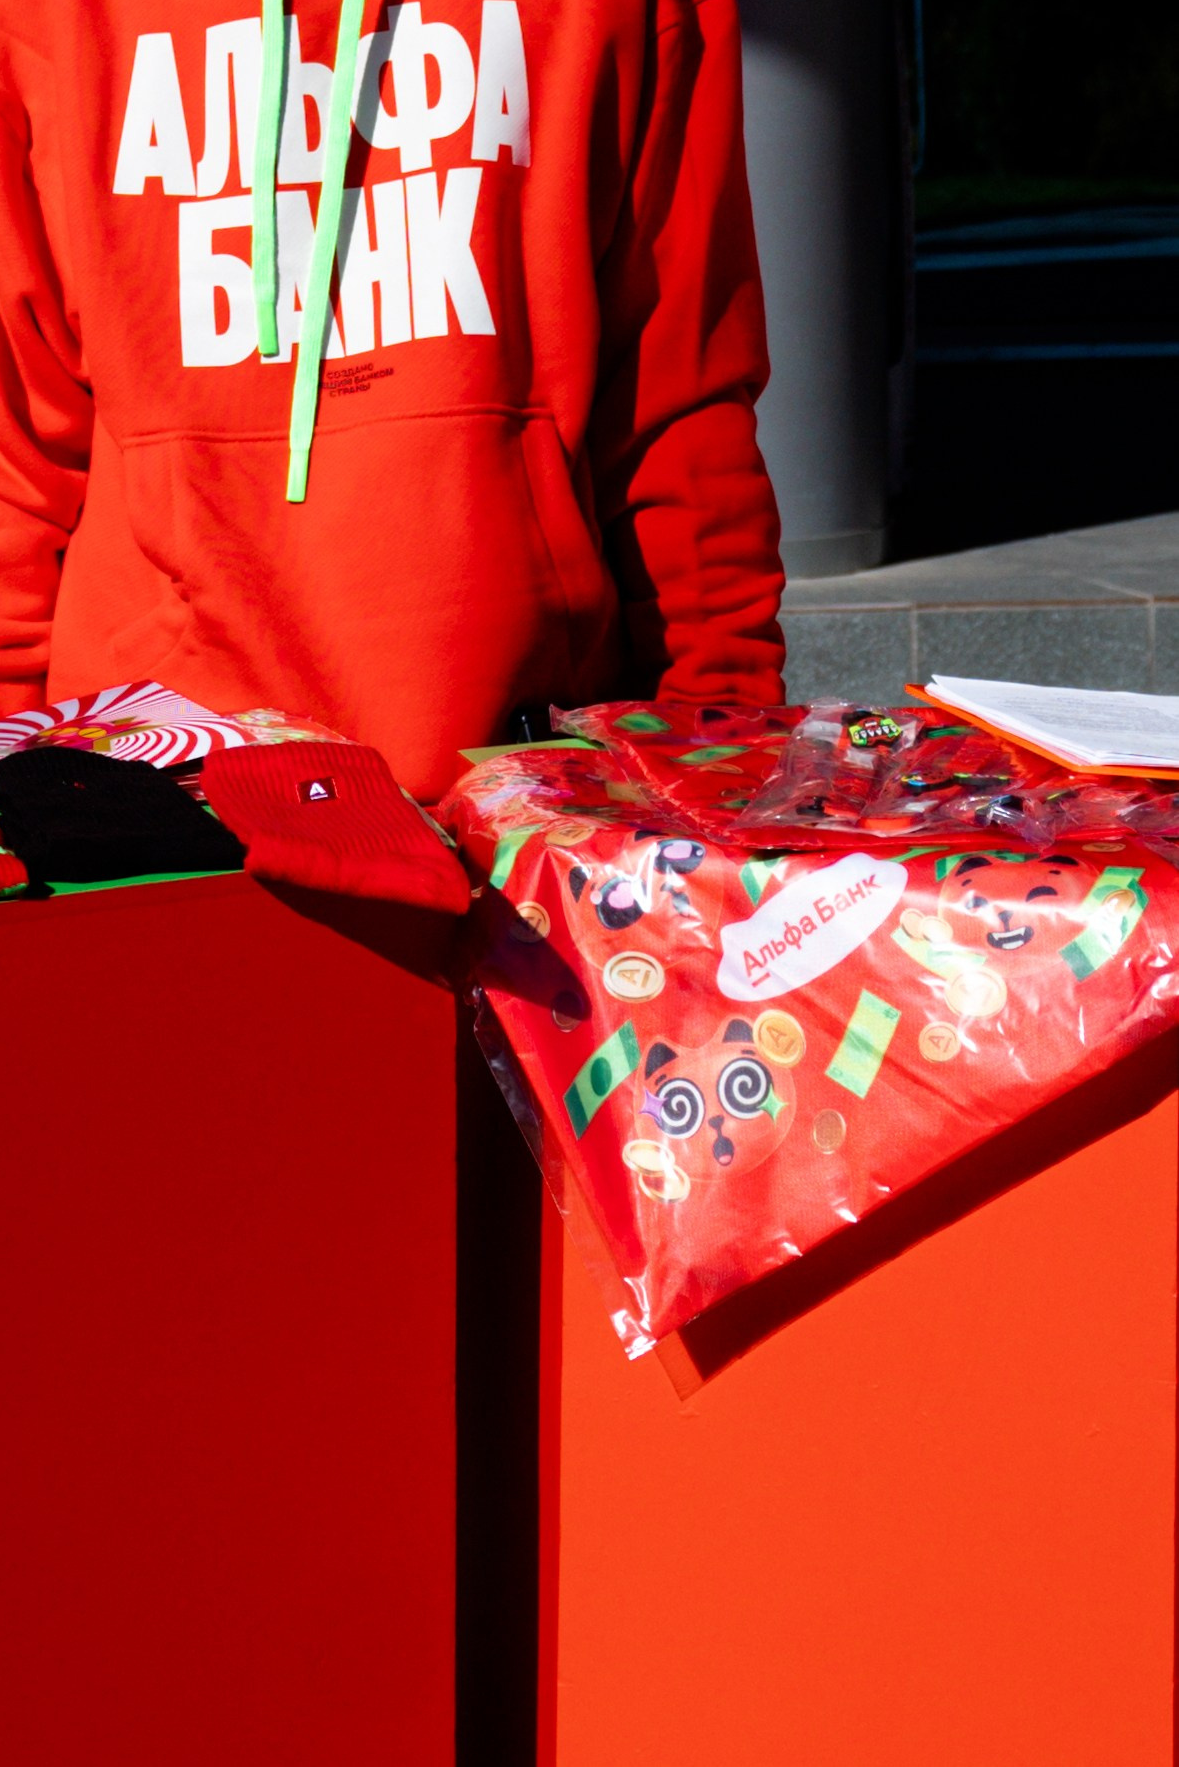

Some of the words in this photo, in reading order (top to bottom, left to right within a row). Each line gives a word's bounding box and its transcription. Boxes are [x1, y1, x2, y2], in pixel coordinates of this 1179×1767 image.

[113, 0, 531, 197] АЛЬФА
[179, 167, 497, 367] БАНК
[329, 383, 371, 398] СТРАНЫ
[743, 915, 818, 979] Альфа
[813, 874, 882, 924] Банк
